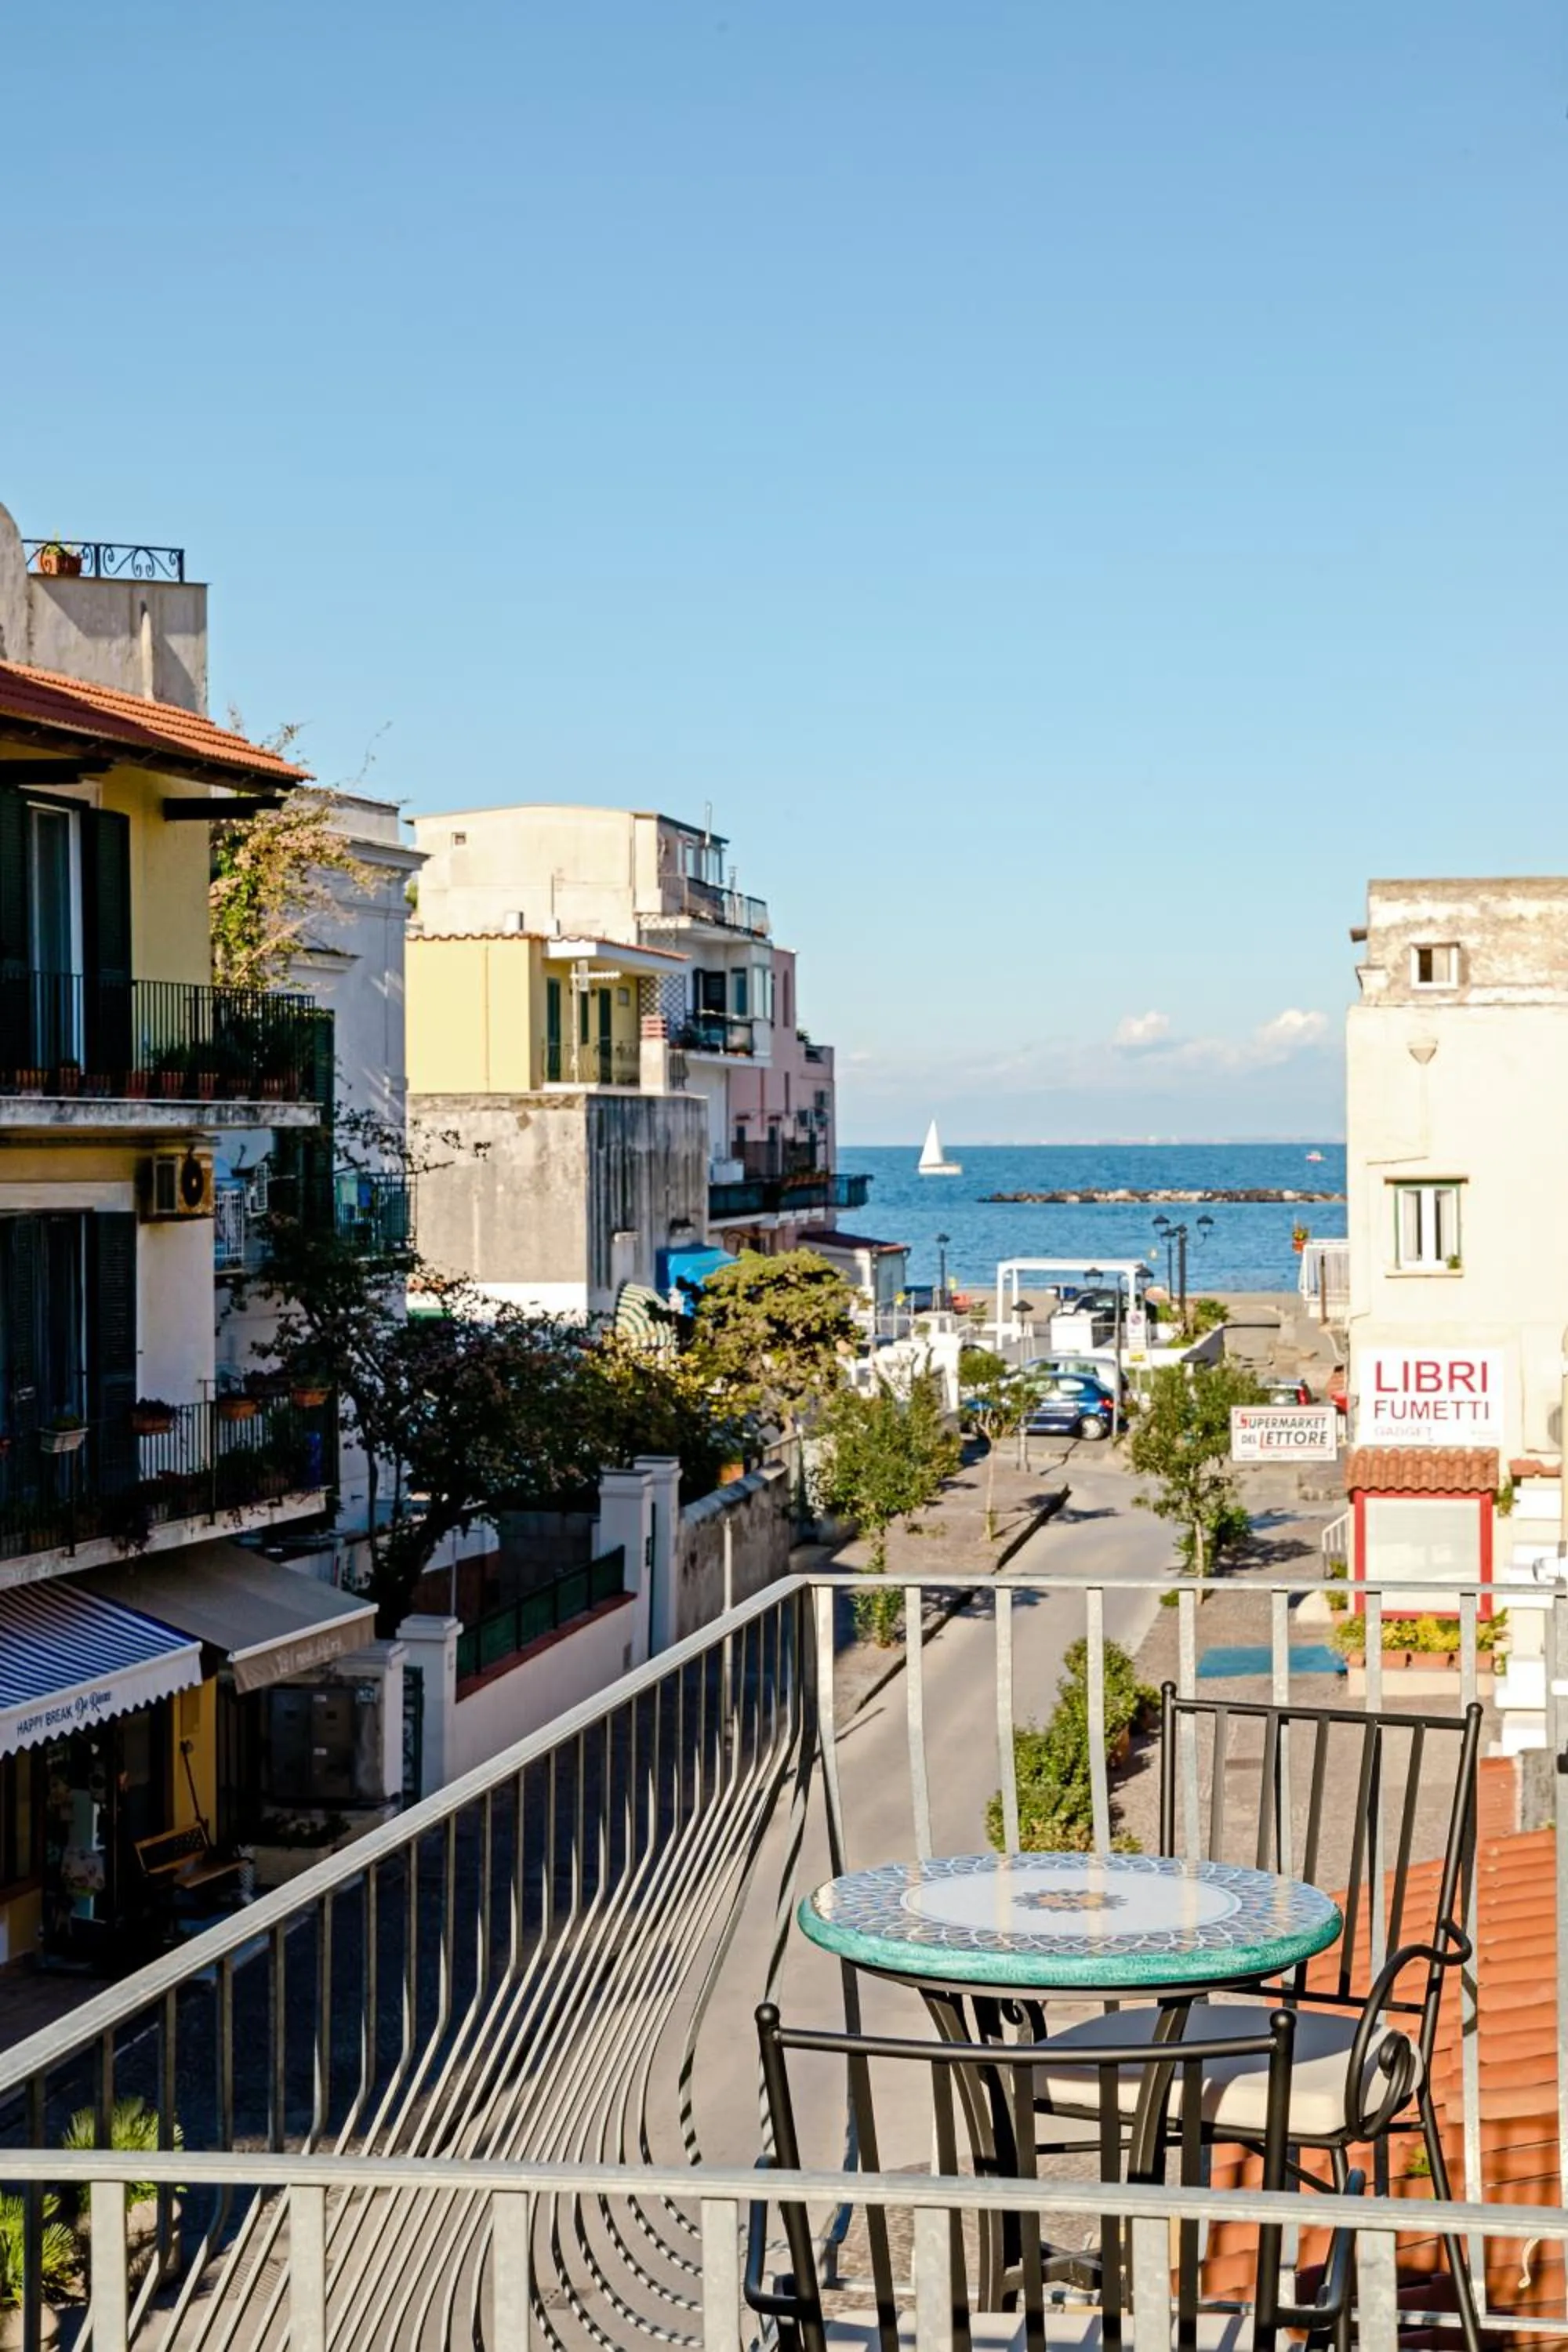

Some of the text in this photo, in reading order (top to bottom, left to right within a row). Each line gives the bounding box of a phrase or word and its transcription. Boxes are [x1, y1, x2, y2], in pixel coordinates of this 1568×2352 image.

[1375, 1361, 1487, 1393] LIBRI
[1374, 1400, 1490, 1420] FUMETTI
[1238, 1413, 1327, 1428] SUPERMARKET
[1260, 1431, 1327, 1449] LETTORE
[17, 1715, 43, 1738] HAPPY
[45, 1706, 73, 1726] BREAK
